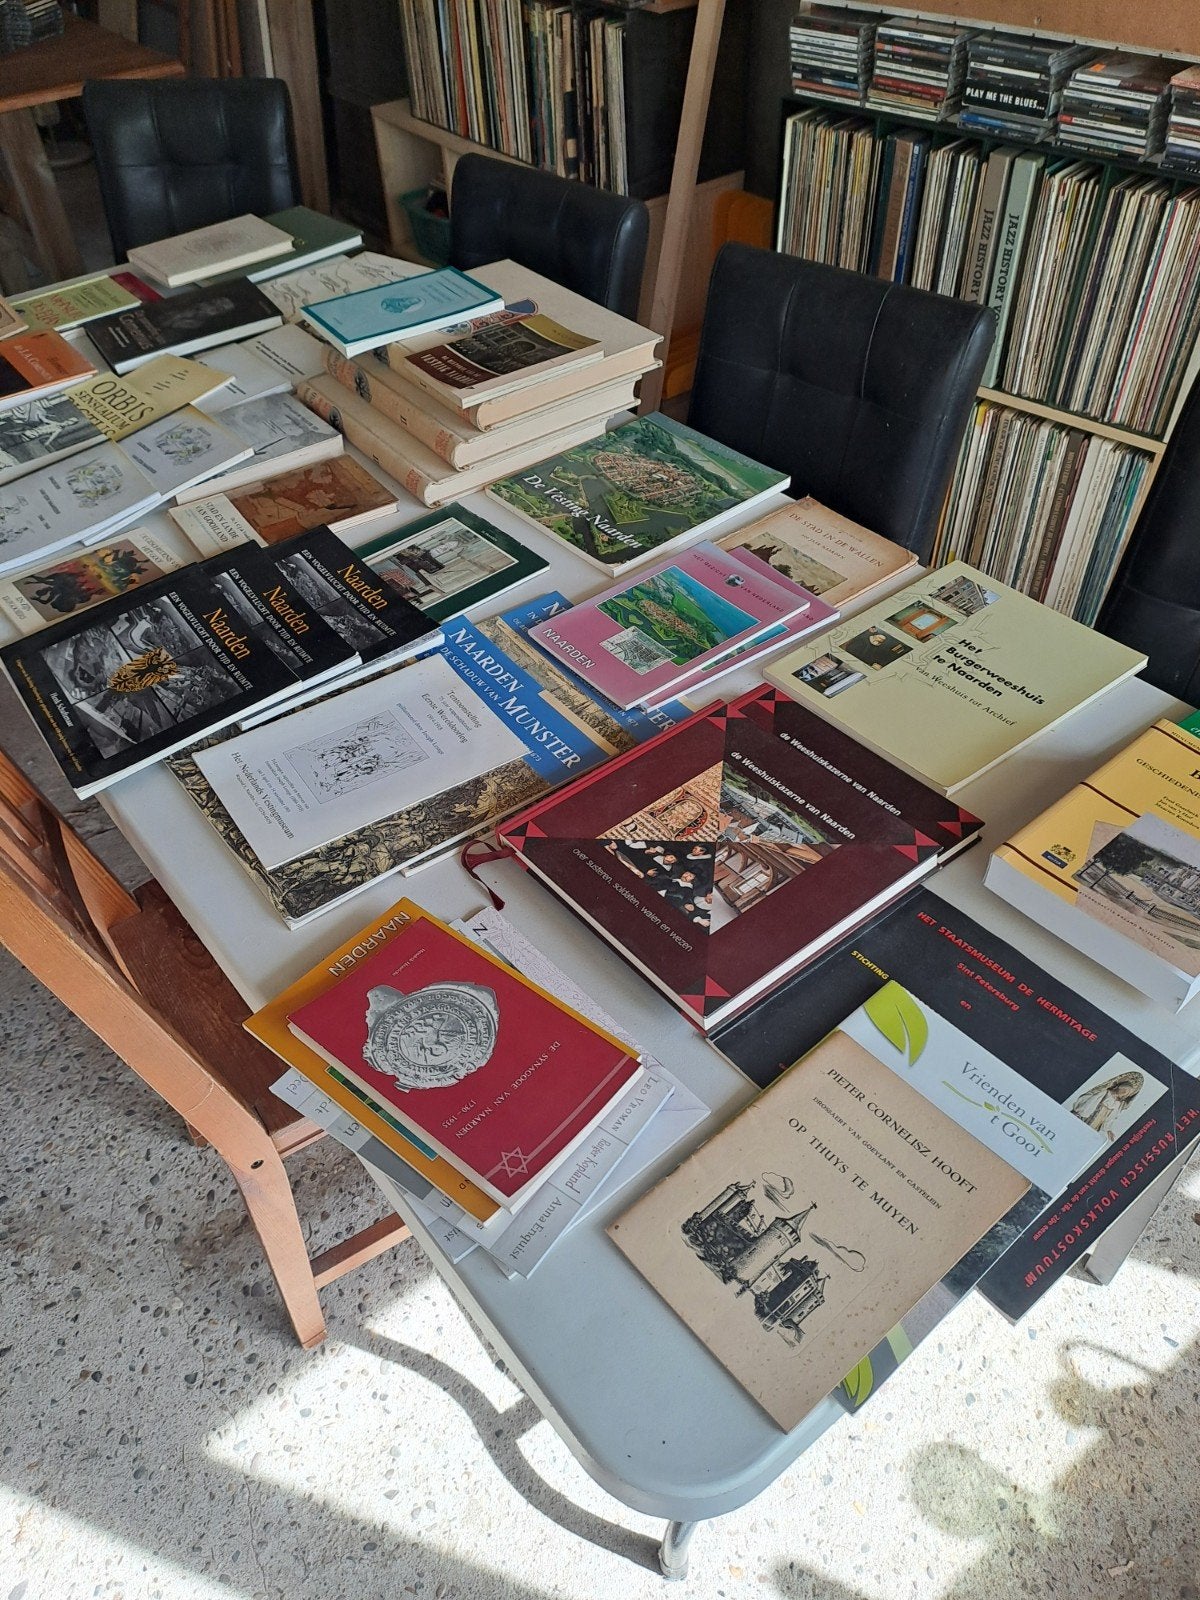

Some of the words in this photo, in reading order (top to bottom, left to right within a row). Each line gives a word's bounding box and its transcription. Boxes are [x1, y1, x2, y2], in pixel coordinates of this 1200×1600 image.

[965, 87, 984, 99] PLAY
[985, 92, 997, 101] ME
[999, 94, 1013, 104] THE
[981, 209, 993, 239] JAZZ
[1005, 214, 1019, 244] JAZZ
[970, 243, 987, 297] HISTORY
[995, 248, 1013, 302] HISTORY
[76, 390, 130, 431] SENSUALIUM
[92, 381, 153, 422] ORBIS
[522, 474, 545, 490] De
[544, 486, 588, 516] Vesting
[586, 513, 642, 549] Naarden
[789, 513, 802, 522] DE
[800, 520, 824, 534] STAD
[834, 539, 850, 549] DE
[849, 546, 884, 567] WALLEN
[263, 586, 311, 635] Naarden
[301, 549, 315, 560] EEN
[311, 559, 347, 593] VOGELVLUCHT
[343, 591, 360, 605] DOOR
[357, 603, 371, 614] TIJD
[367, 613, 378, 621] EN
[375, 619, 397, 637] RUIMTE
[337, 564, 389, 610] Naarden
[203, 608, 251, 660] Naarden
[228, 567, 240, 579] EEN
[238, 579, 270, 616] VOGELVLUCHT
[266, 614, 282, 630] DOOR
[278, 628, 291, 640] TIJD
[286, 638, 297, 647] EN
[292, 645, 313, 664] RUIMTE
[169, 591, 181, 604] EEN
[177, 602, 210, 639] VOGELVLUCHT
[205, 638, 221, 654] DOOR
[217, 652, 231, 666] TIJD
[227, 663, 237, 673] EN
[233, 671, 253, 691] RUIMTE
[448, 627, 524, 695] NAARDEN
[542, 627, 596, 670] NAARDEN
[958, 638, 983, 655] Het
[915, 666, 930, 677] van
[931, 675, 969, 700] Weeshuis
[969, 697, 982, 708] tot
[983, 708, 1017, 726] Archief
[933, 654, 947, 665] te
[947, 663, 1003, 698] Naarden
[946, 646, 1046, 705] Burgerweeshuis
[440, 647, 455, 658] DE
[449, 656, 487, 687] SCHADUW
[483, 687, 501, 701] VAN
[497, 695, 582, 769] MUNSTER
[231, 752, 243, 764] Het
[239, 764, 265, 795] Nederlands
[261, 794, 295, 839] Vestingmuseum
[730, 750, 742, 761] de
[741, 757, 806, 805] Weeshuiskazerne
[805, 803, 821, 816] van
[819, 812, 857, 840] Naarden
[779, 731, 792, 742] de
[789, 738, 854, 784] Weeshuiskazerne
[851, 781, 867, 794] van
[866, 791, 902, 816] Naarden
[572, 847, 588, 861] over
[585, 859, 614, 884] susteren,
[612, 882, 642, 908] soldaten,
[640, 906, 663, 925] walen
[659, 923, 671, 932] en
[669, 931, 694, 952] wezen
[327, 910, 406, 978] NAARDEN
[851, 950, 890, 980] STICHTING
[917, 911, 937, 926] HET
[938, 926, 1017, 982] STAATSMUSEUM
[1017, 983, 1034, 995] DE
[1036, 996, 1098, 1042] HERMITAGE
[956, 962, 976, 978] Sint
[974, 975, 1021, 1011] Petersburg
[959, 999, 972, 1010] en
[549, 1040, 561, 1053] DE
[511, 1053, 549, 1090] SYNAGOGE
[640, 1076, 659, 1097] LEO
[442, 1115, 458, 1129] 1935
[455, 1106, 493, 1139] NAARDEN
[461, 1099, 477, 1114] 1730
[493, 1090, 511, 1107] VAN
[611, 1096, 644, 1132] VROMAN
[962, 1061, 1026, 1117] Vrienden
[1030, 1116, 1057, 1142] van
[813, 1097, 848, 1128] DROSSAERT
[846, 1127, 862, 1141] VAN
[861, 1140, 896, 1170] GOEYLANT
[896, 1169, 907, 1180] EN
[827, 1068, 866, 1102] PIETER
[866, 1101, 931, 1158] CORNELISZ
[931, 1156, 977, 1196] HOOFT
[1000, 1120, 1045, 1158] Gooi
[564, 1155, 598, 1195] Kopland
[788, 1117, 807, 1136] OP
[809, 1136, 850, 1174] THUYS
[850, 1173, 868, 1191] TE
[869, 1190, 920, 1236] MUYEN
[1120, 1132, 1175, 1188] RUSSISCH
[542, 1196, 563, 1222] Anna
[1033, 1223, 1049, 1241] eeuw
[509, 1219, 546, 1262] Enquist
